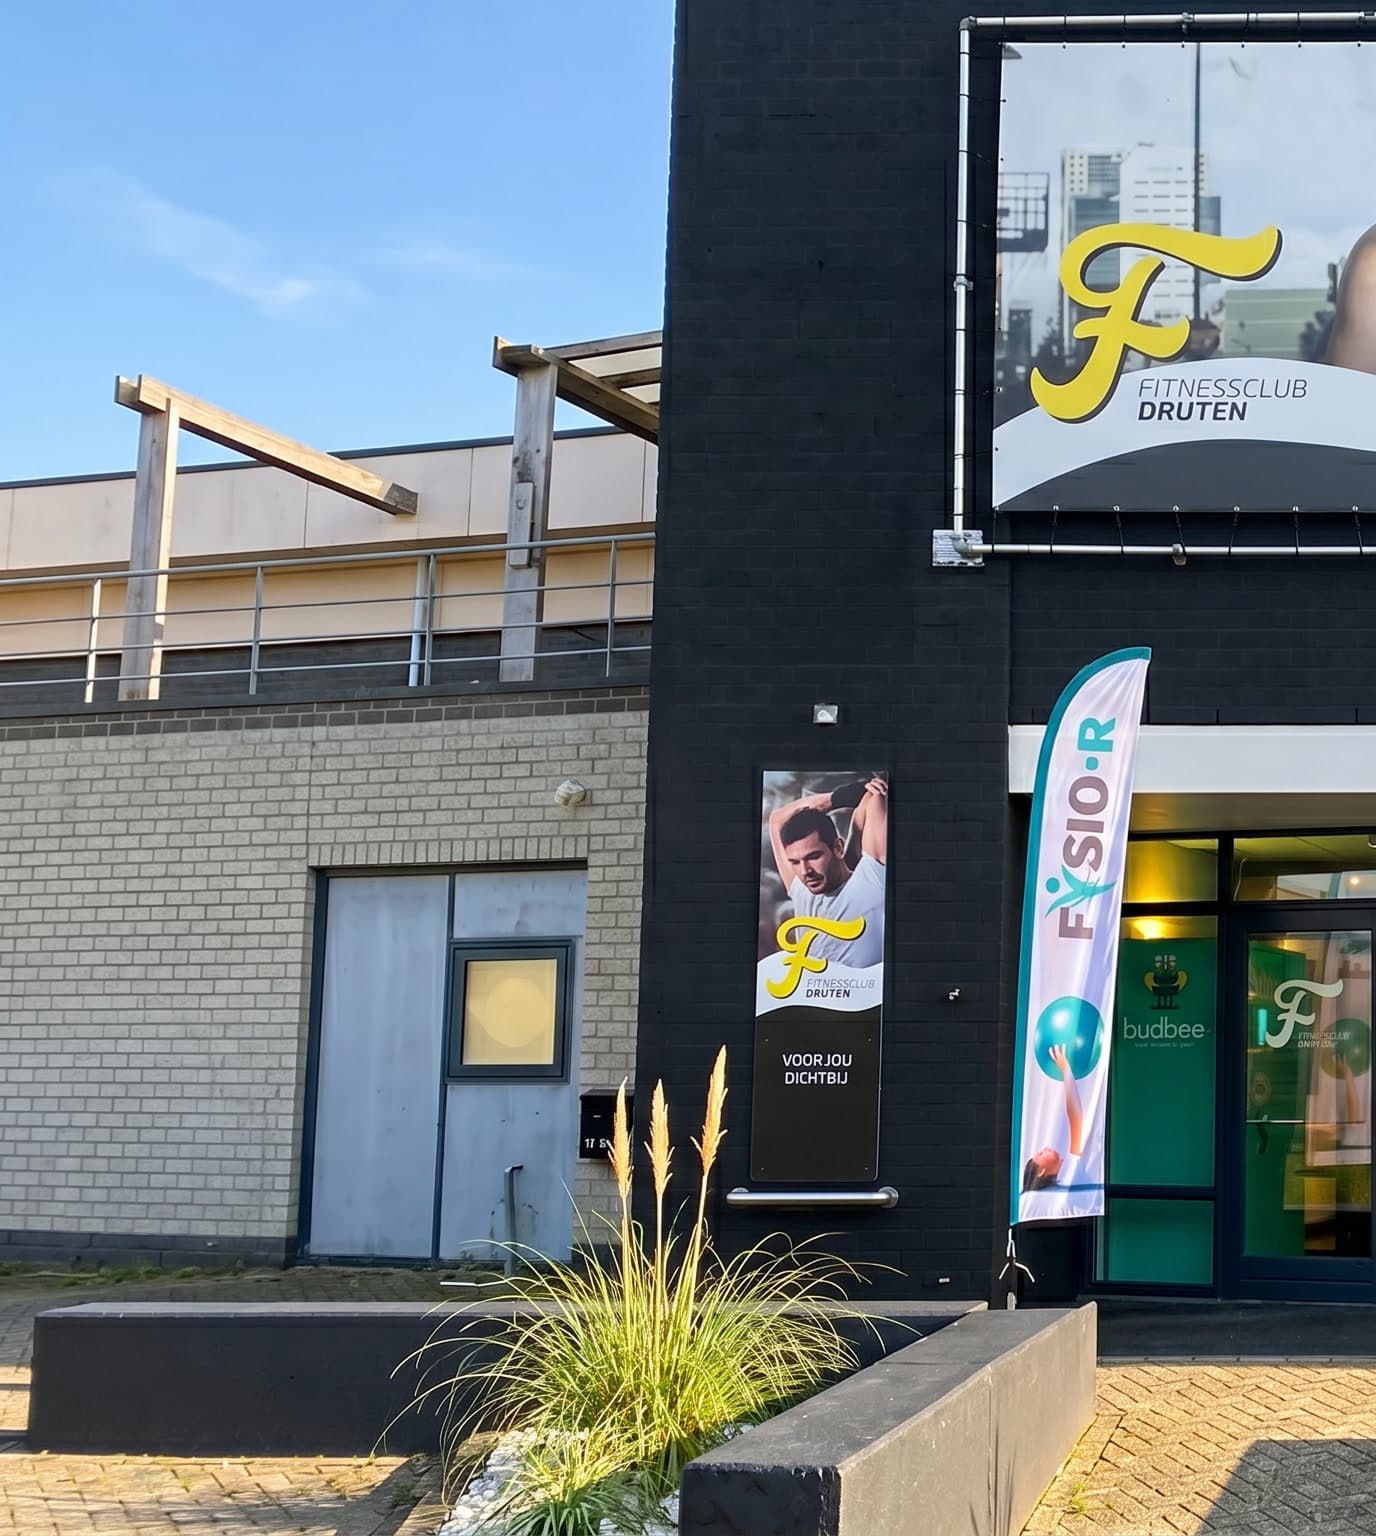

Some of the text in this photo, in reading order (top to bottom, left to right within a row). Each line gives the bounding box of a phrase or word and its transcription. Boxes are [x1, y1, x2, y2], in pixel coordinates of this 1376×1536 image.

[1138, 378, 1308, 398] FITNESSCLUB
[1138, 401, 1248, 421] DRUTEN
[806, 978, 876, 989] FITNESSCLUB
[805, 989, 851, 998] DRUTEN
[1123, 1015, 1206, 1040] budbee
[782, 1054, 853, 1067] VOOR JOU
[785, 1071, 849, 1085] DICHTBIJ
